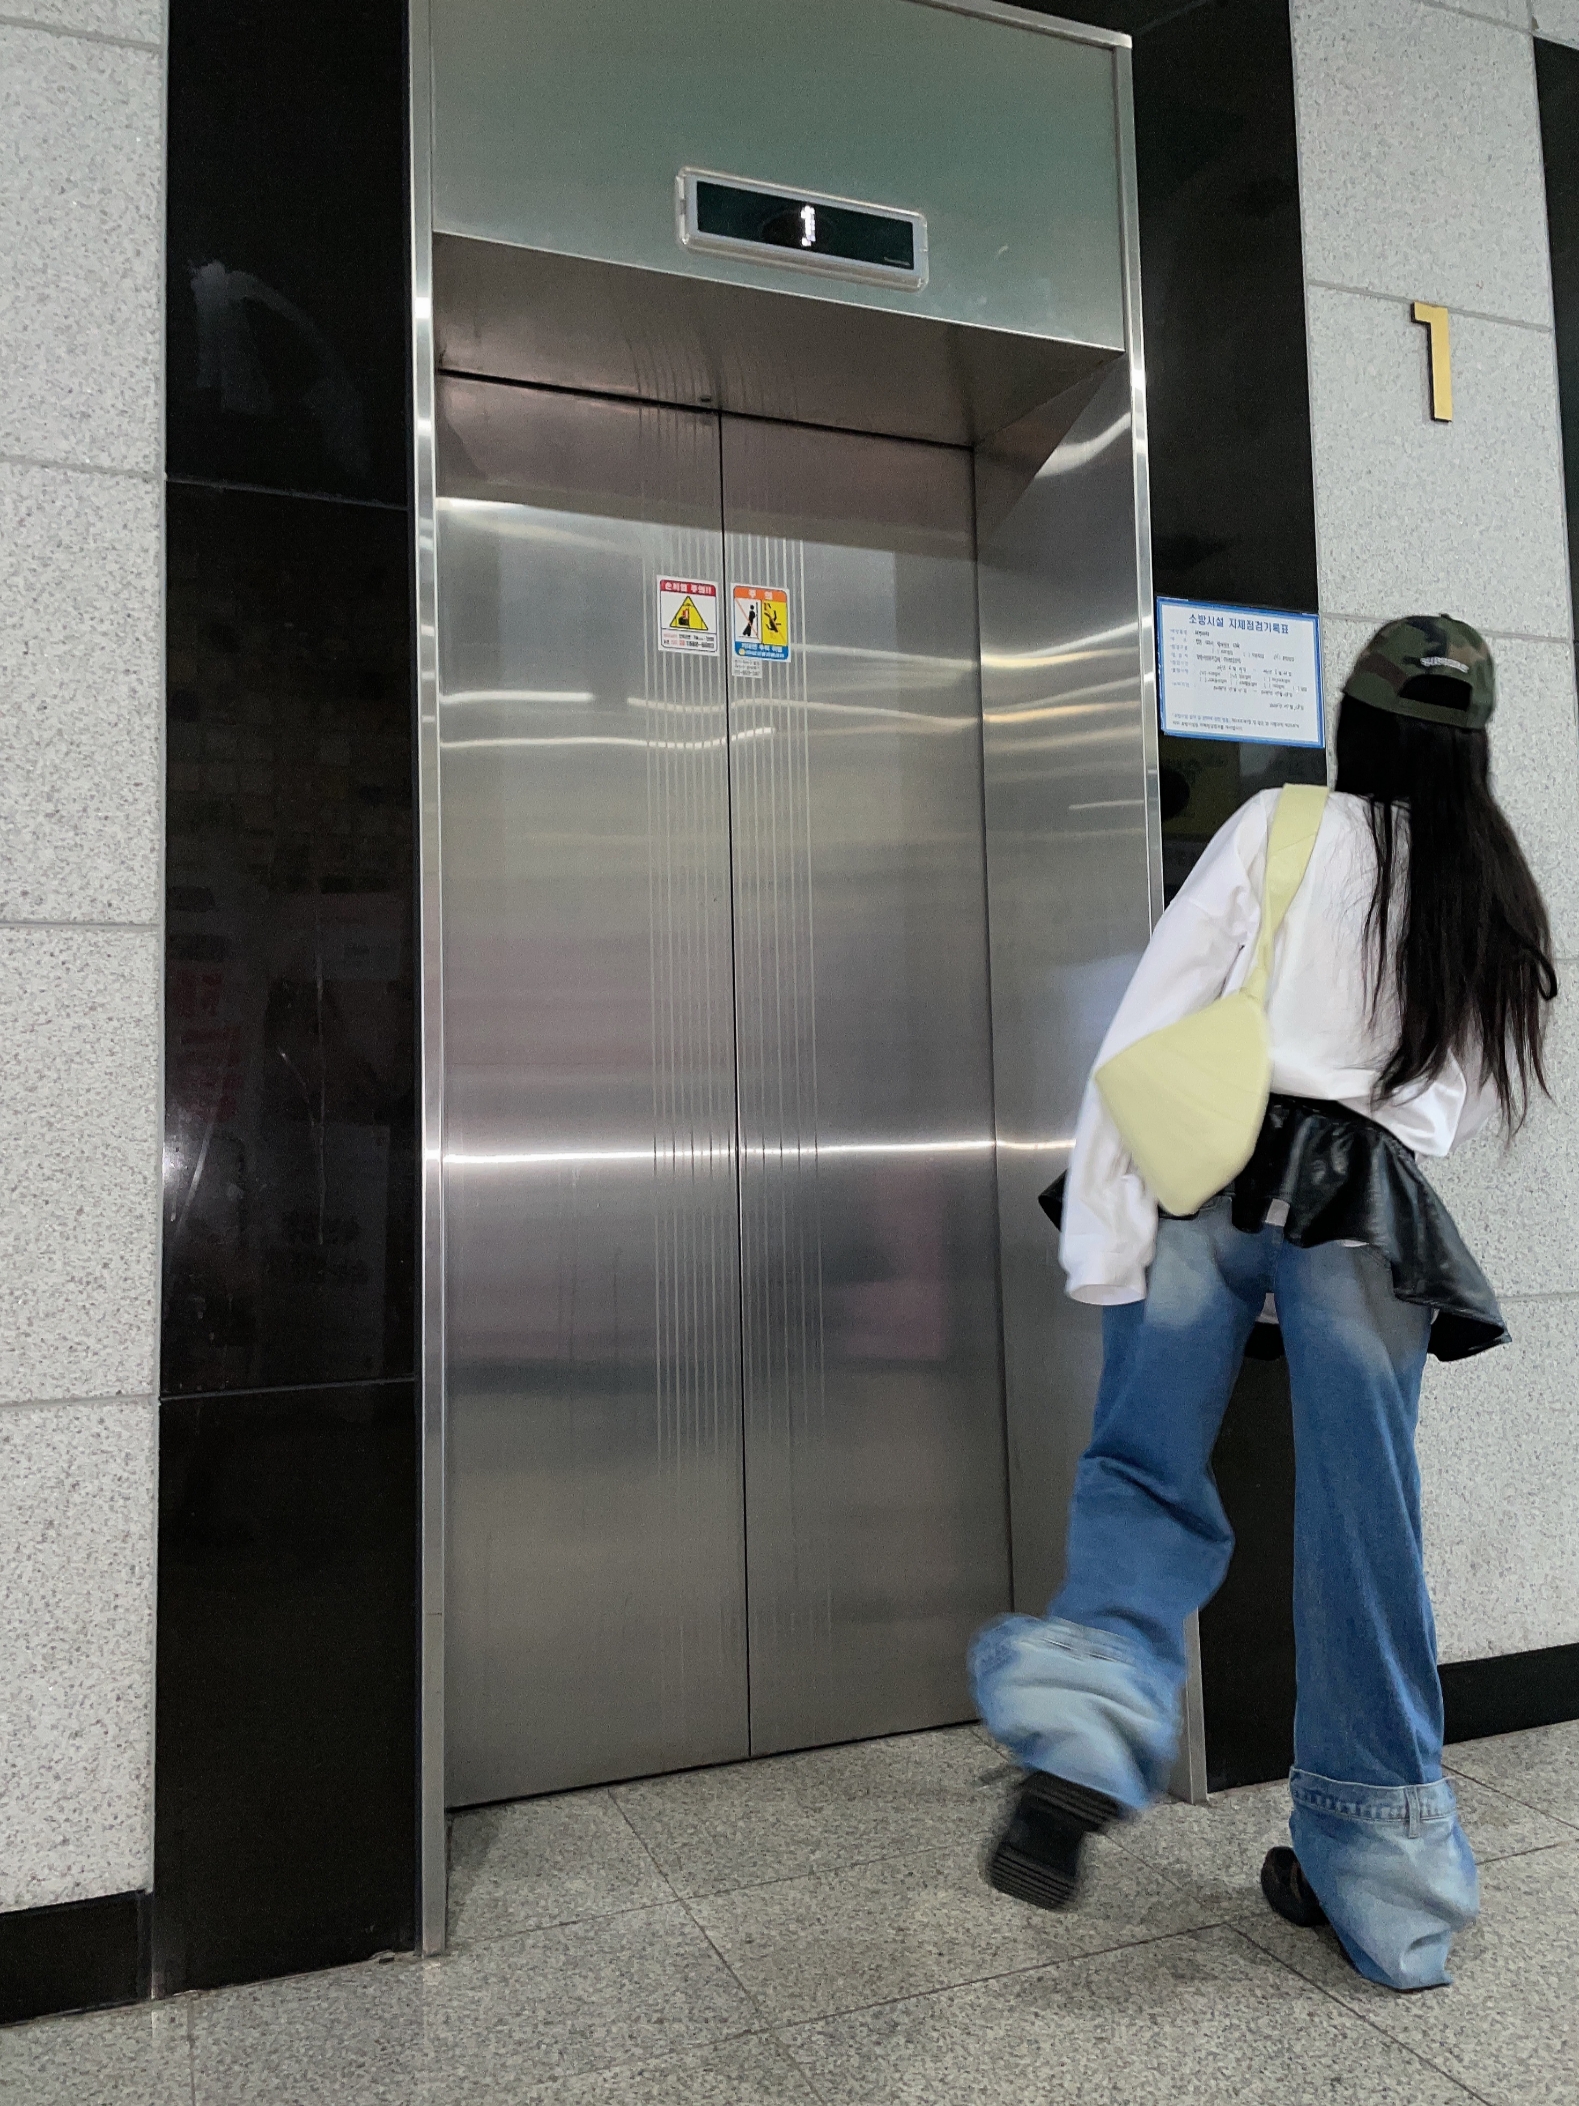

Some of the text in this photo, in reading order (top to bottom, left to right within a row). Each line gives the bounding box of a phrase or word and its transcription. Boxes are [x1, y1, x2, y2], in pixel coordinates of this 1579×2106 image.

[801, 205, 816, 247] 1
[1410, 301, 1453, 422] 1
[1189, 614, 1224, 627] 소방시설
